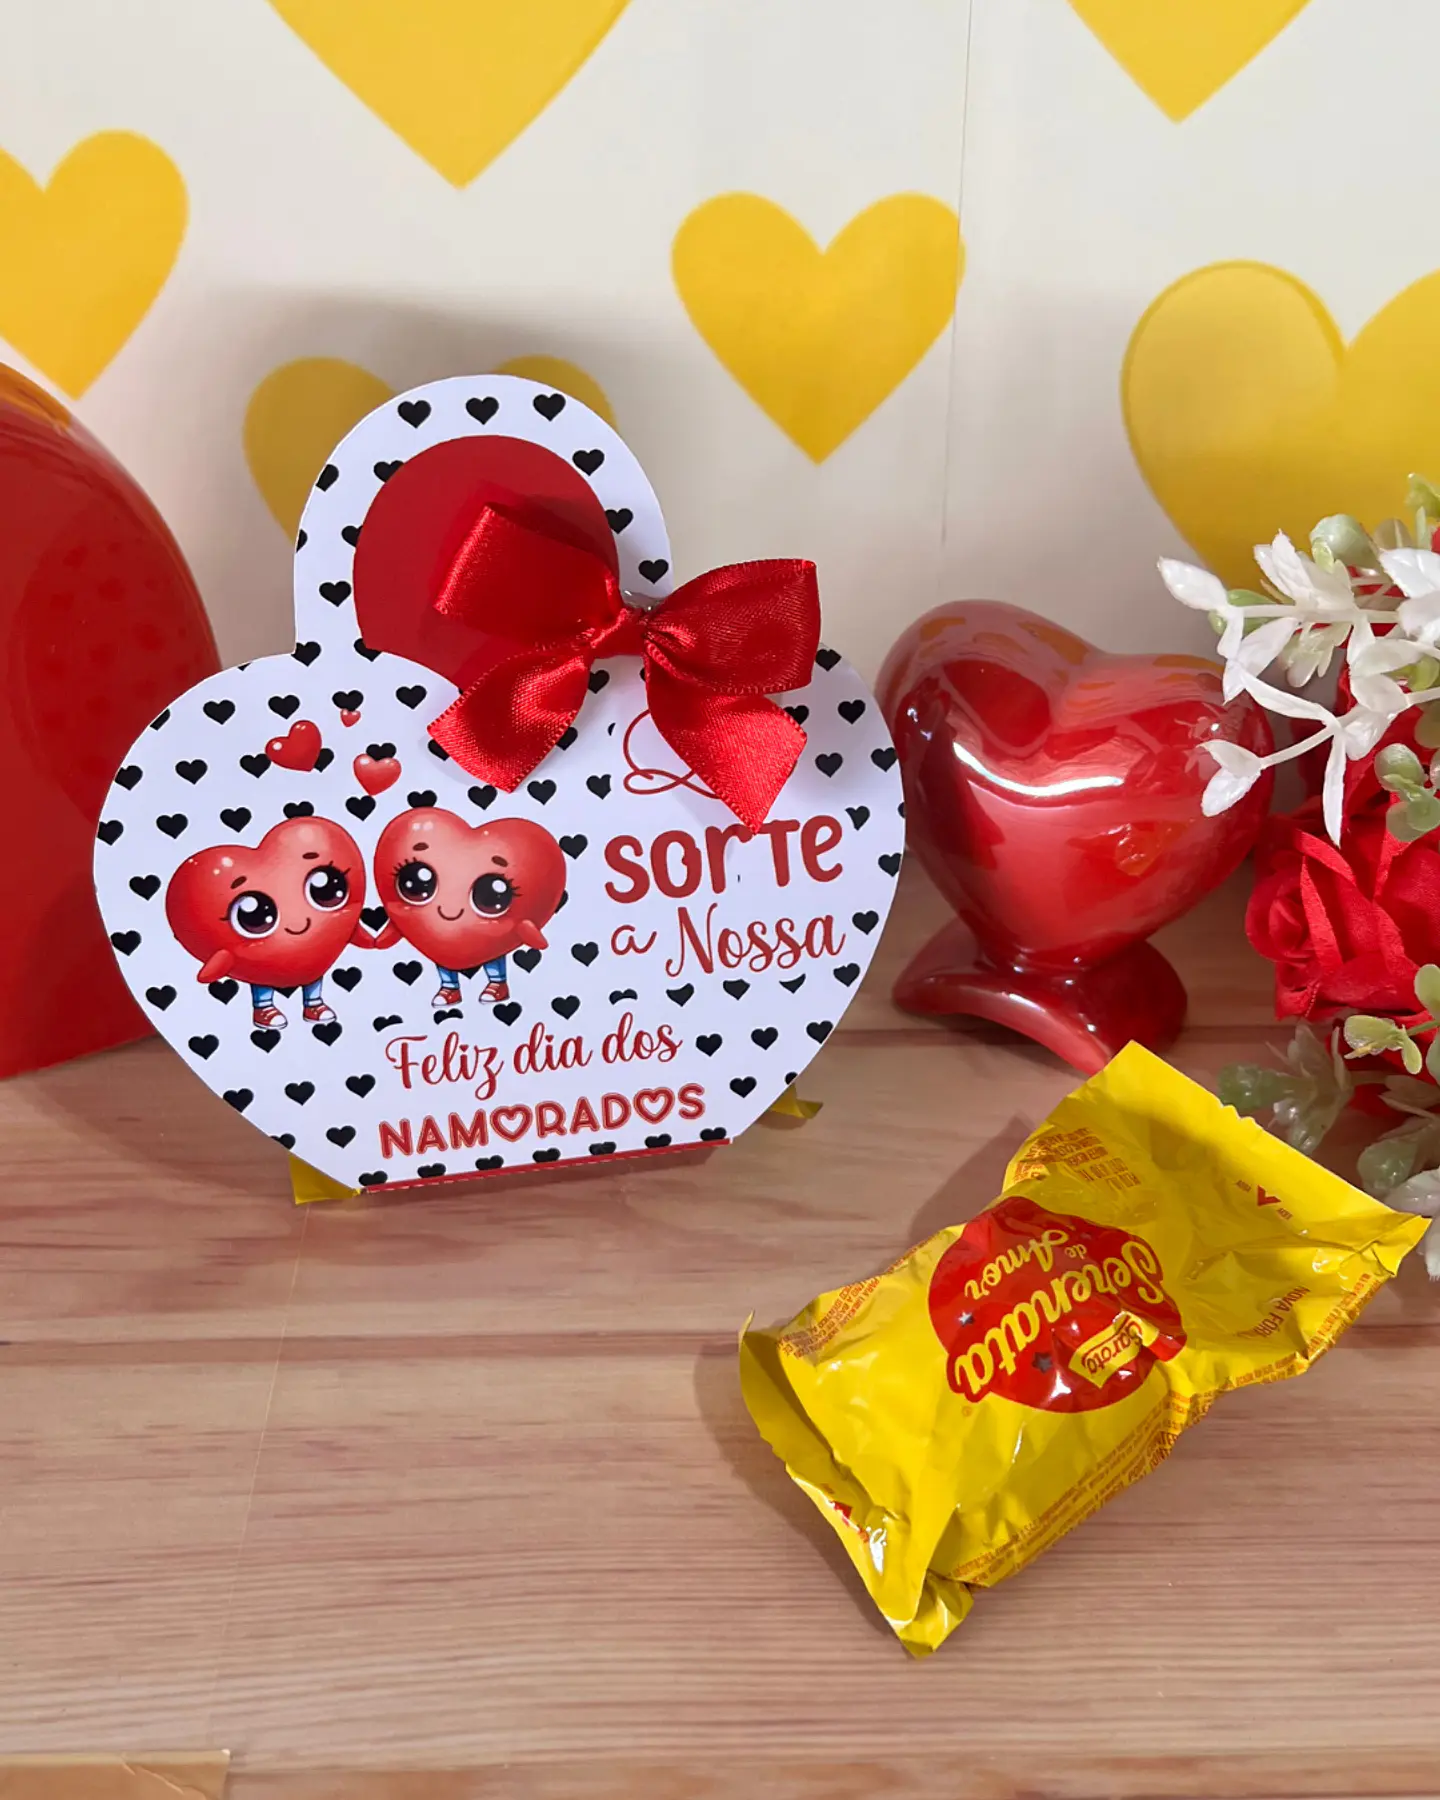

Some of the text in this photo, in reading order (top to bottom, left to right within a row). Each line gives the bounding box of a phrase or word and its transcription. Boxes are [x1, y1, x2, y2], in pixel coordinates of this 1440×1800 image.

[610, 902, 846, 977] a Nossa
[385, 1012, 683, 1101] Feliz dia dos
[378, 1082, 706, 1159] NAMORADOS
[964, 1229, 1069, 1300] Amor
[1064, 1243, 1087, 1260] de
[954, 1240, 1165, 1395] Serenata
[1275, 1285, 1311, 1312] NOVA
